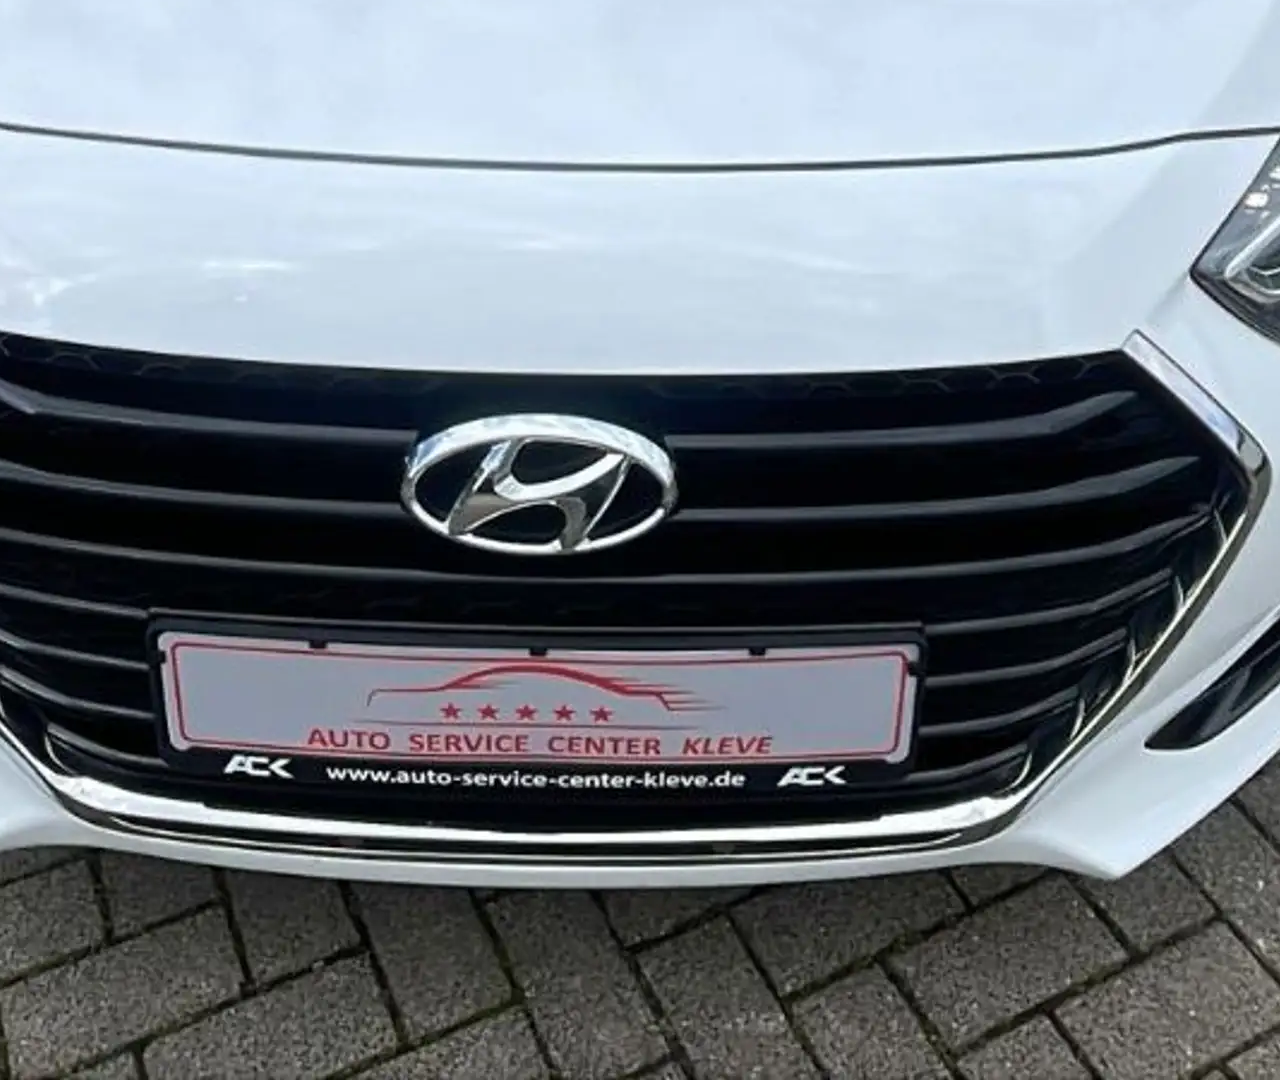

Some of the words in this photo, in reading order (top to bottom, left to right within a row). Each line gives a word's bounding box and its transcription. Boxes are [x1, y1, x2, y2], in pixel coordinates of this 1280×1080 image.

[307, 728, 391, 751] AUTO
[409, 733, 529, 753] SERVICE
[548, 736, 661, 755] CENTER
[682, 736, 773, 755] KLEVE
[326, 766, 746, 789] www.auto-service-center-kleve.de
